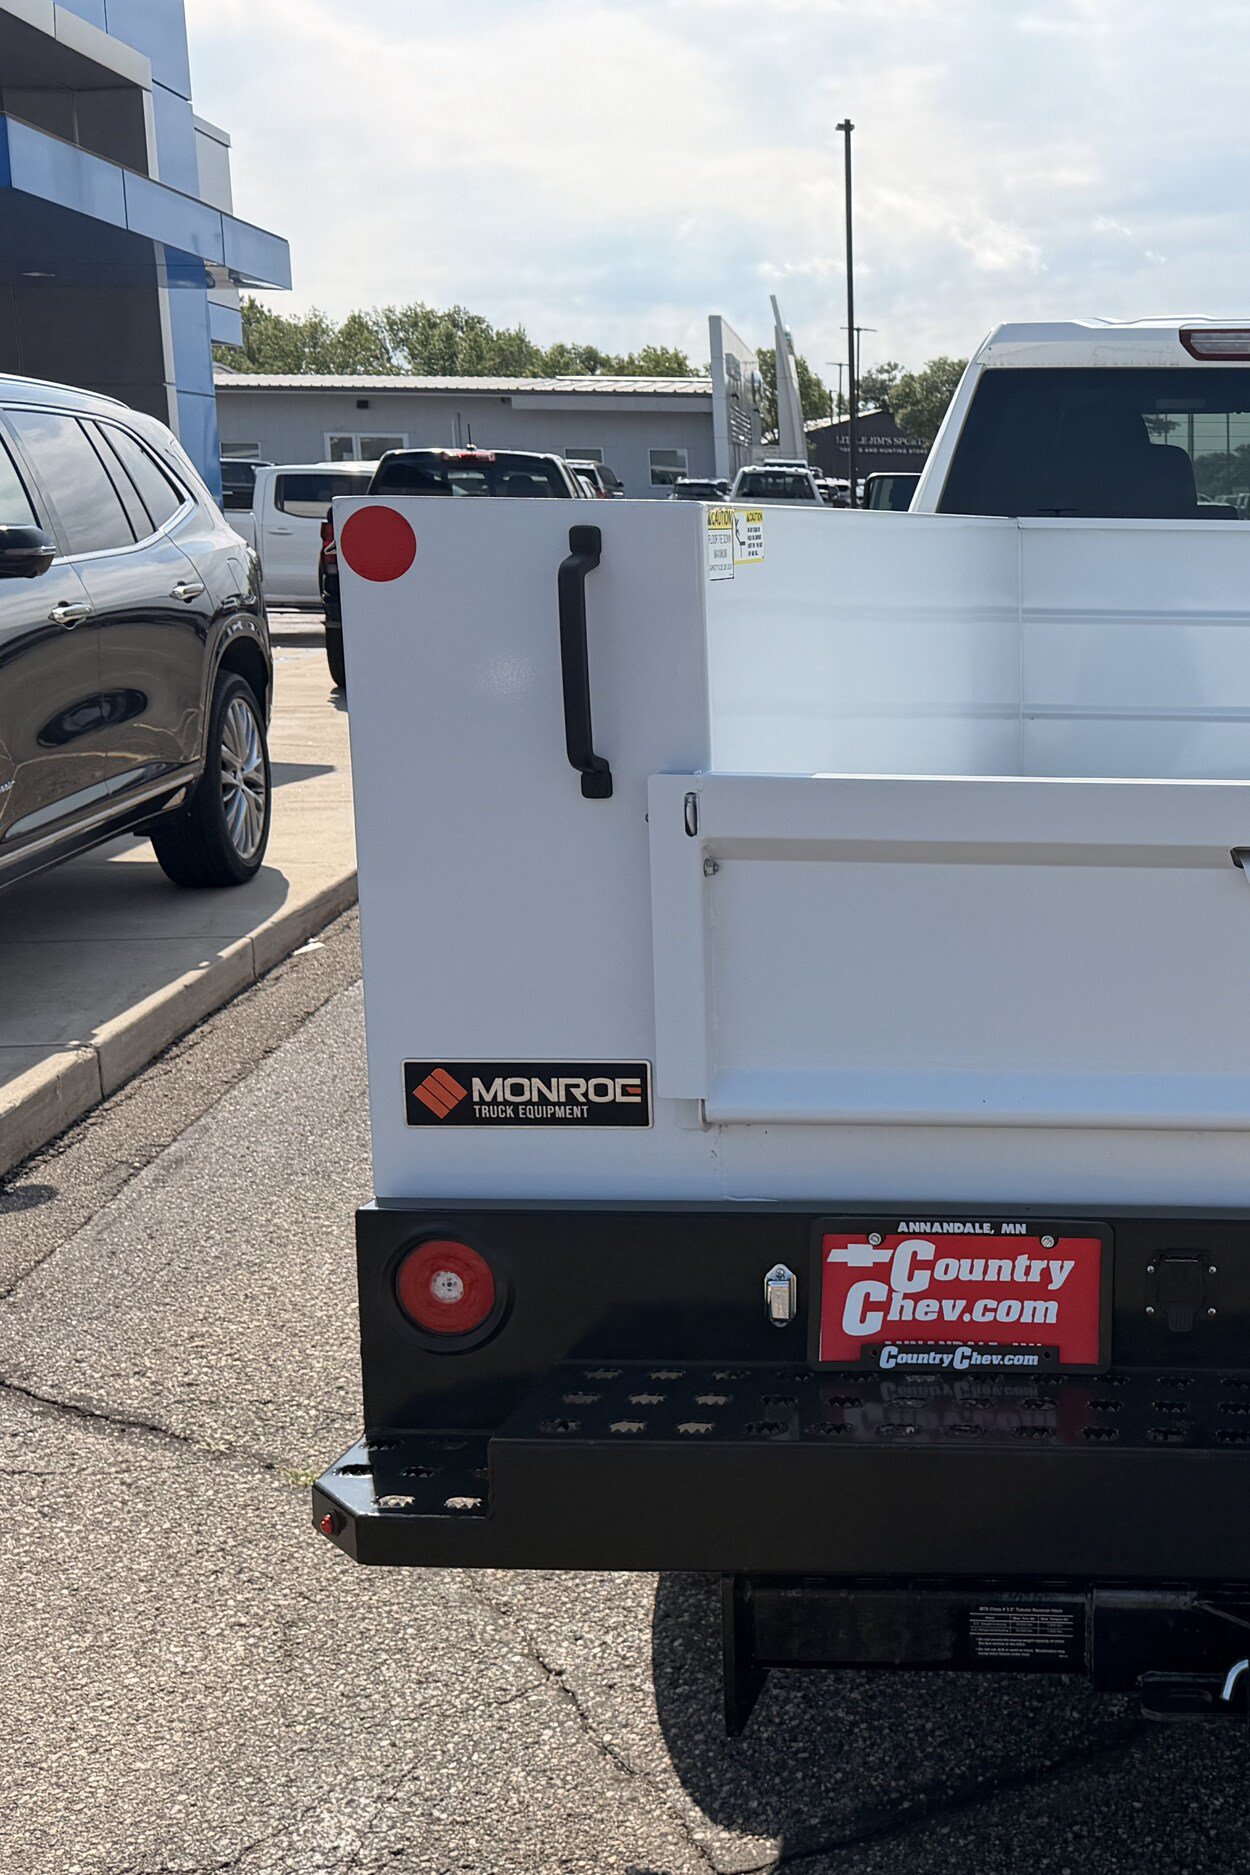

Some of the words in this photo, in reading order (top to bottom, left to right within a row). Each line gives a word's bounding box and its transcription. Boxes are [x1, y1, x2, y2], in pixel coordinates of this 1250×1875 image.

[836, 436, 868, 445] LITLE
[869, 436, 892, 445] JIM'S
[471, 1076, 642, 1103] MONROE
[473, 1105, 515, 1118] TRUCK
[518, 1105, 589, 1119] EQUIPMENT
[897, 1221, 995, 1235] ANNANDALE,
[1001, 1223, 1027, 1235] MN
[890, 1239, 1075, 1293] Country
[842, 1280, 1059, 1336] Chev.com
[879, 1345, 1039, 1370] CountryChev.com
